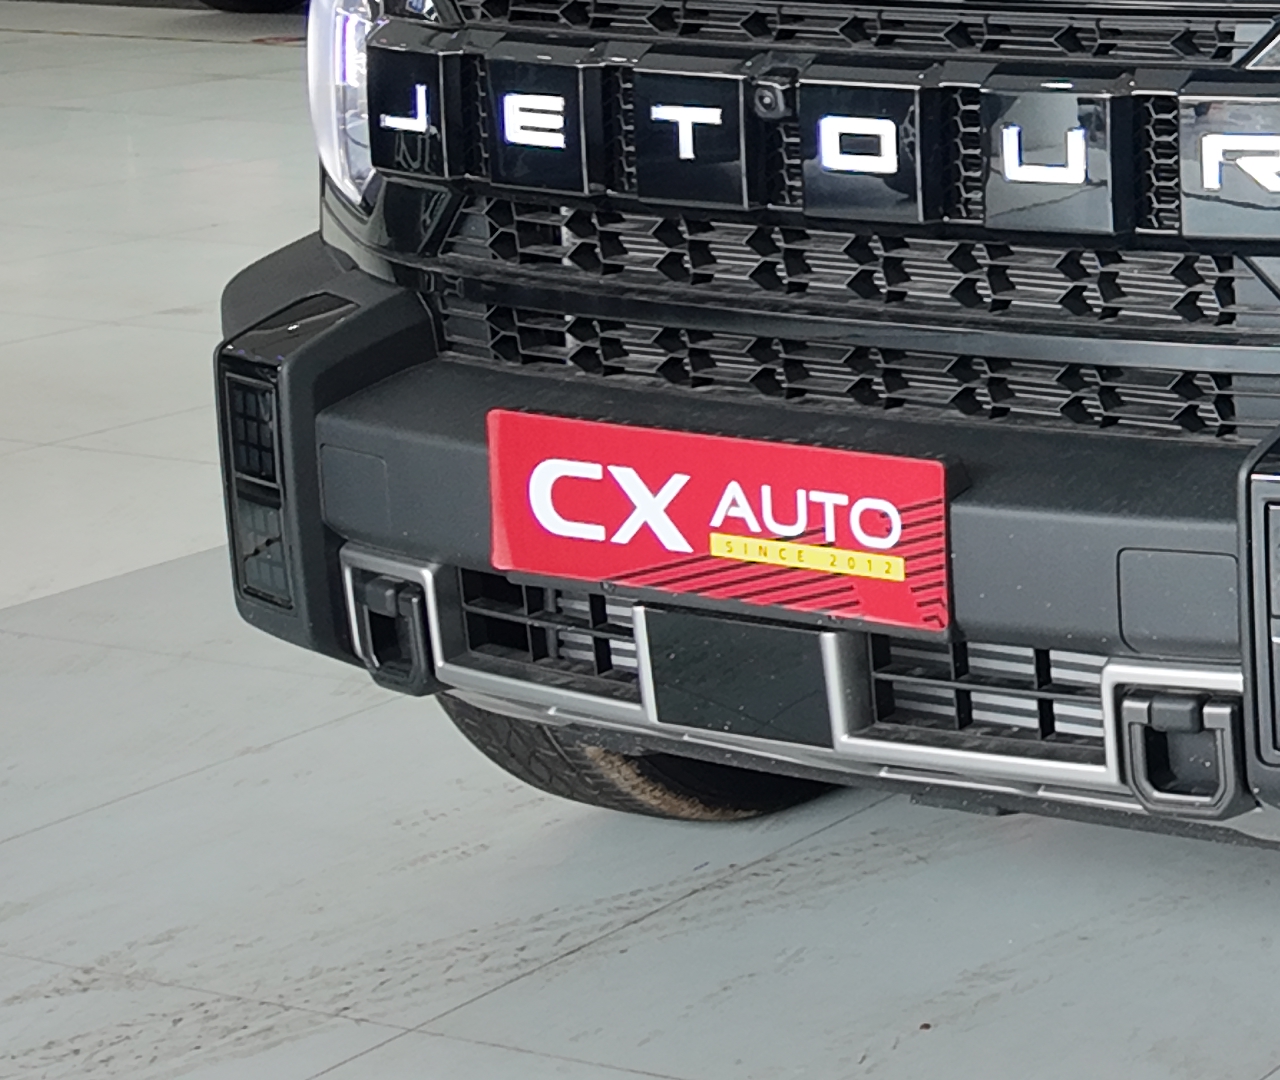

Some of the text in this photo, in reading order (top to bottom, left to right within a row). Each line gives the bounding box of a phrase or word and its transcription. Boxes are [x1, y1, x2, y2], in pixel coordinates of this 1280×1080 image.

[529, 458, 902, 553] CX AUTO
[725, 541, 893, 574] SINCE 2012
